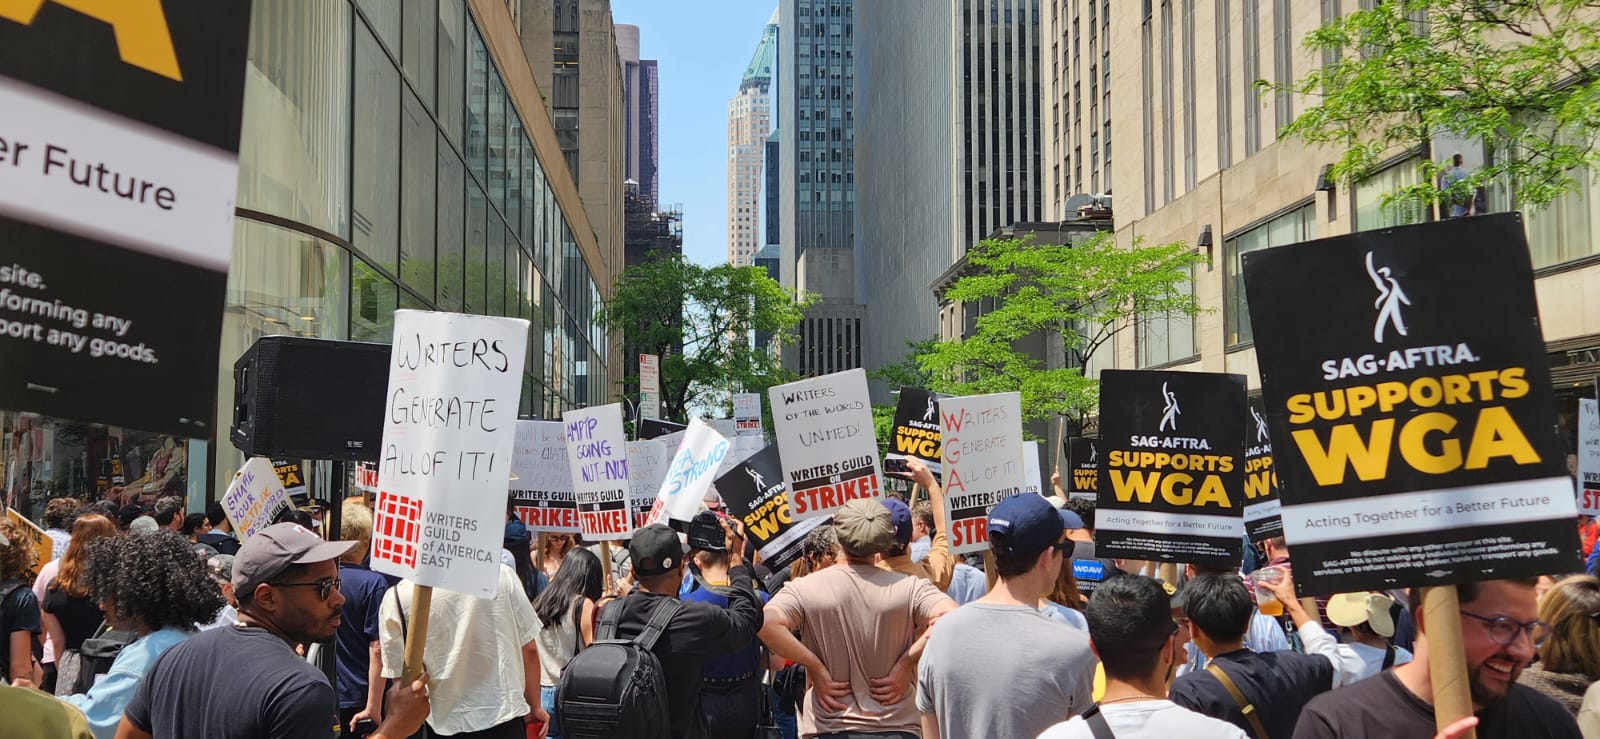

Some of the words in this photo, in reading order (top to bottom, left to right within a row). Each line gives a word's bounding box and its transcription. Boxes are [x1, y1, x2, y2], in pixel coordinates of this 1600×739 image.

[43, 144, 176, 211] Future
[0, 263, 47, 290] site.
[92, 312, 132, 337] any
[46, 328, 88, 353] any
[90, 337, 158, 364] goods.
[398, 332, 509, 373] WRITERS
[782, 387, 836, 406] WRITERS
[1286, 367, 1530, 425] SUPPORTS
[391, 387, 498, 433] GENERATE
[785, 412, 799, 421] OF
[800, 408, 820, 418] THE
[824, 401, 864, 414] WORLD
[942, 404, 1008, 433] WRITERS
[577, 440, 611, 460] GOING
[945, 435, 1008, 464] GENERATE
[1291, 406, 1542, 487] WGA
[384, 443, 416, 478] ALL
[421, 451, 447, 477] OF
[458, 451, 496, 483] IT!
[669, 441, 728, 496] STRONG
[790, 462, 840, 482] WRITERS
[842, 455, 873, 471] GUILD
[1108, 450, 1234, 473] SUPPORTS
[829, 474, 841, 484] ON
[945, 468, 980, 495] ALL
[985, 465, 998, 480] OF
[1108, 469, 1232, 508] WGA
[1244, 470, 1278, 499] W
[551, 491, 576, 501] GUIL
[577, 491, 599, 503] WRITERS
[600, 489, 624, 501] GUILD
[794, 474, 879, 514] STRIKE!
[950, 491, 995, 510] WRITERS
[233, 494, 256, 523] YOUR
[268, 499, 287, 521] GUILD
[426, 512, 478, 531] WRITERS
[580, 508, 628, 535] STRIKE!
[1304, 514, 1351, 530] Acting
[1353, 508, 1420, 524] Together
[1422, 504, 1443, 517] for
[1445, 505, 1453, 515] a
[1456, 500, 1496, 514] Better
[1501, 494, 1550, 510] Future
[424, 525, 461, 542] GUILD
[1106, 516, 1130, 525] Acting
[1133, 518, 1164, 527] Together
[1165, 520, 1176, 528] for
[1183, 521, 1206, 530] Better
[1207, 523, 1233, 531] Future
[421, 553, 452, 569] EAST
[422, 540, 434, 551] of
[437, 542, 493, 564] AMERICA
